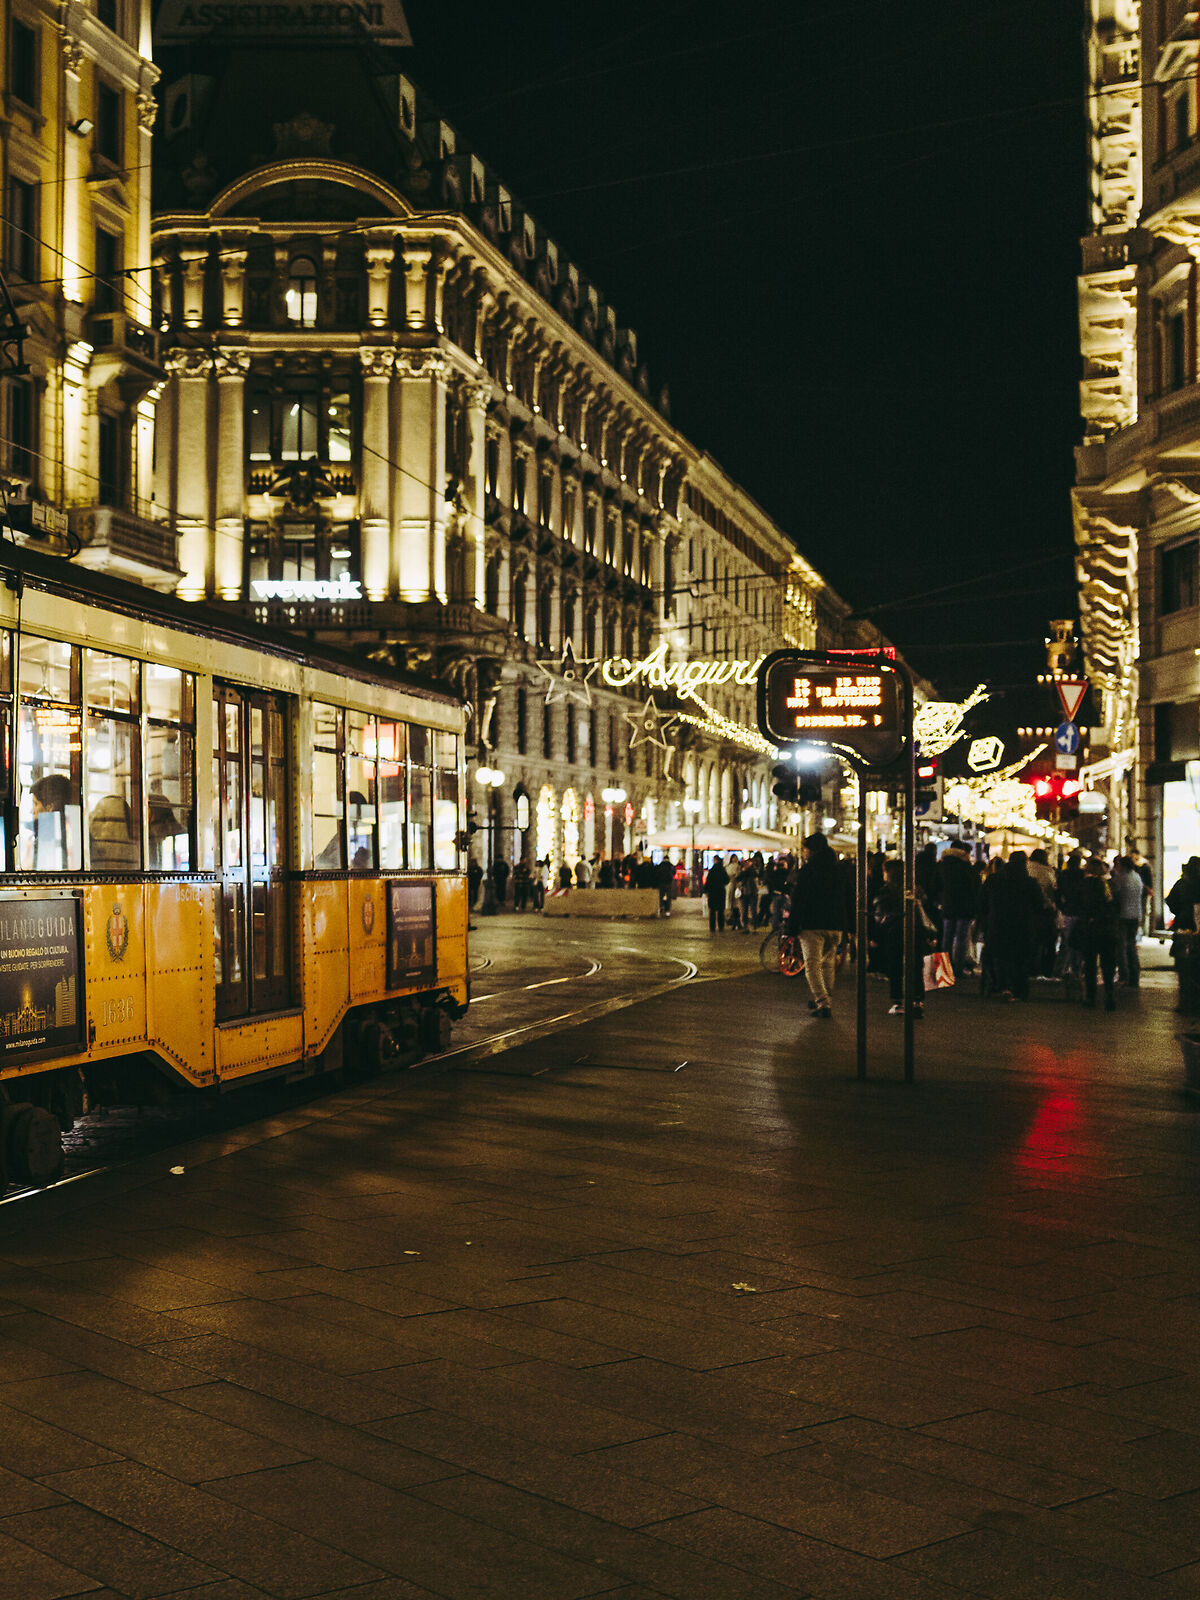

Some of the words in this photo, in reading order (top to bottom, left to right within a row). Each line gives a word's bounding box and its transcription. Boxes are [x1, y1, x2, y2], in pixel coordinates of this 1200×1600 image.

[178, 4, 384, 26] ASSICURAZIONI
[603, 642, 767, 699] Auguri
[103, 995, 135, 1027] 1636
